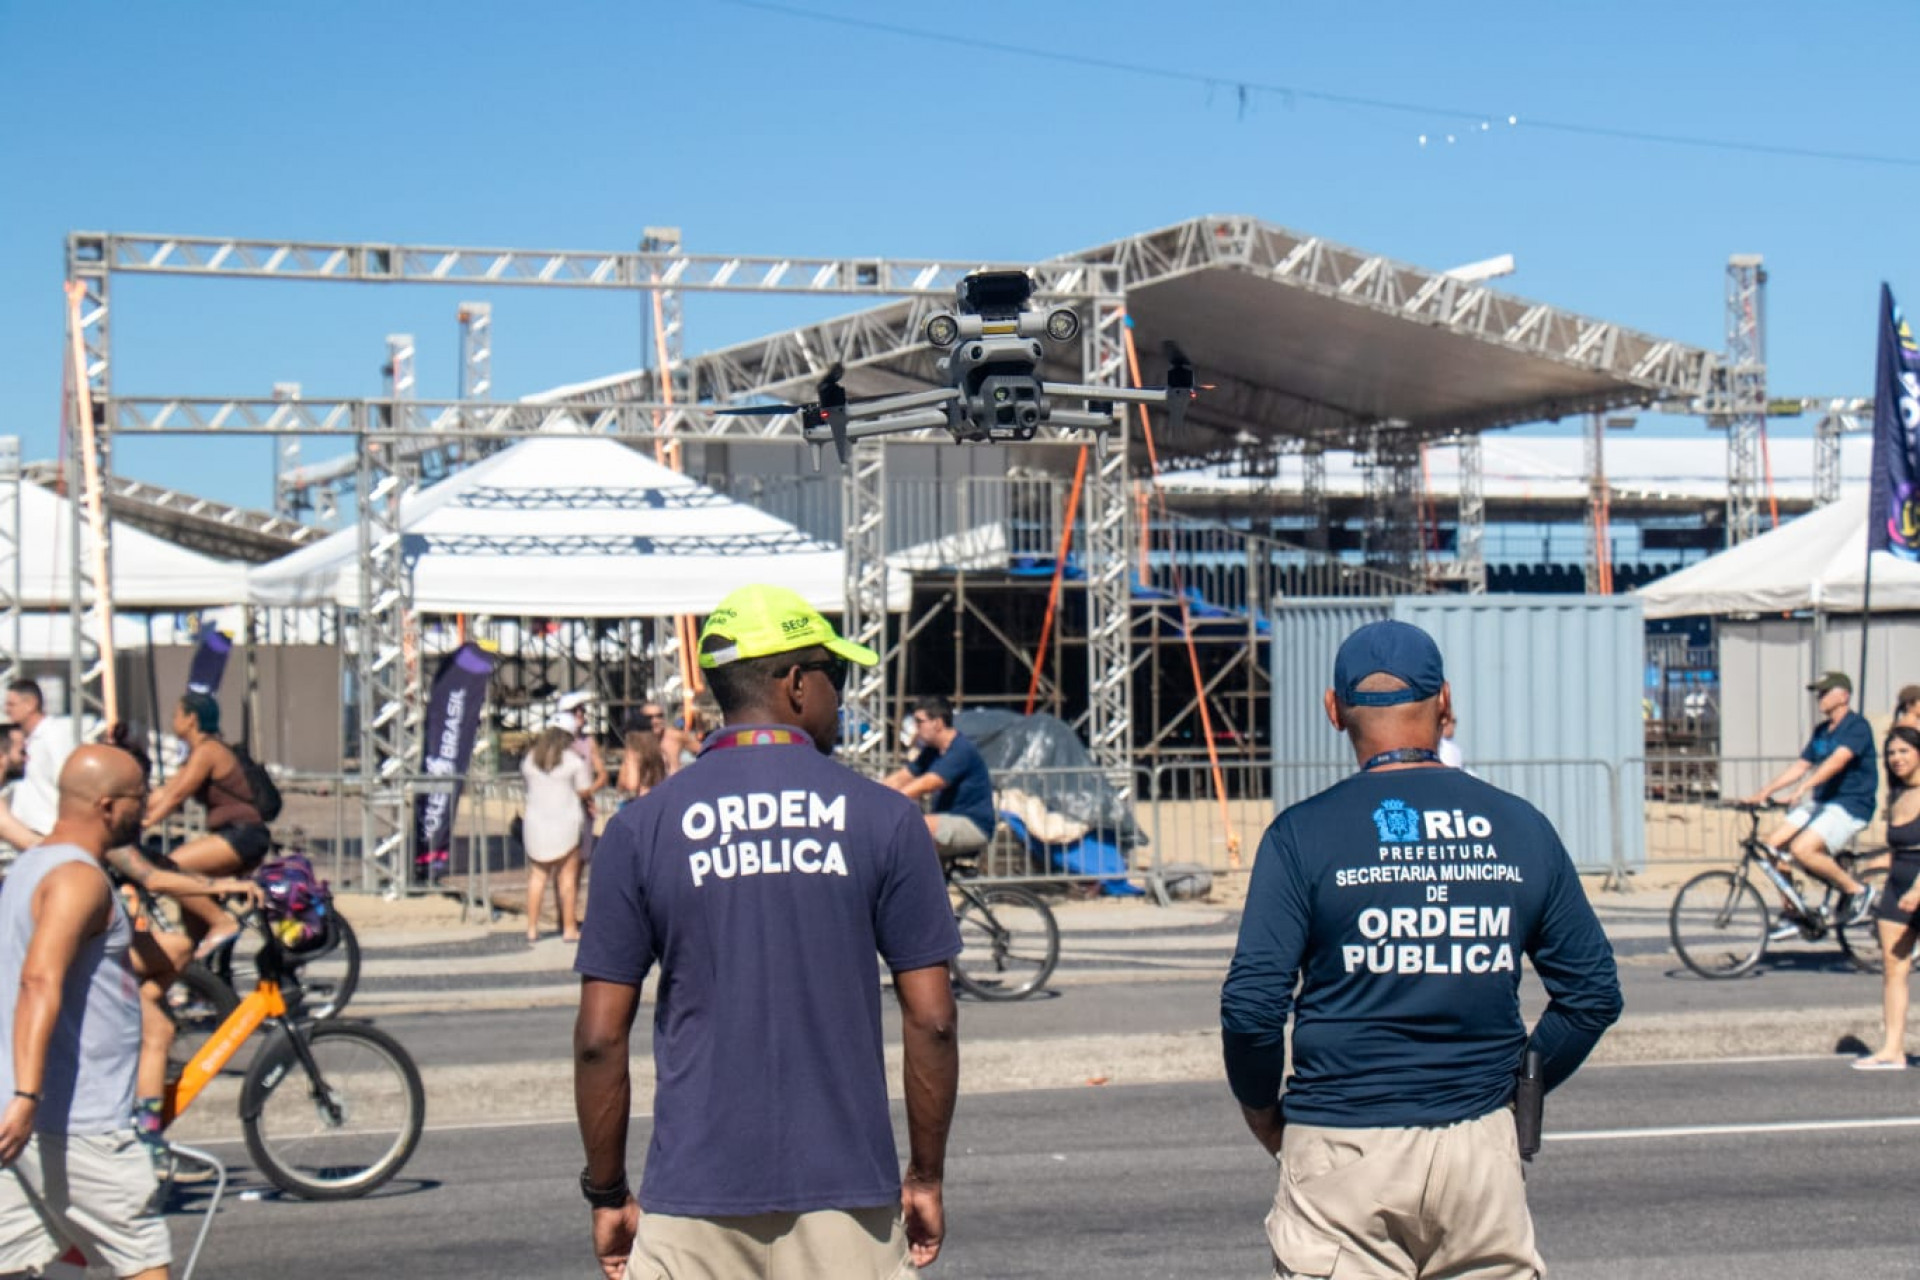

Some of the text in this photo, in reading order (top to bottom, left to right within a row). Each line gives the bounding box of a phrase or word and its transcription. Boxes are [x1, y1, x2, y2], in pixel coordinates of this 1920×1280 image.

[439, 688, 467, 759] BRASIL
[681, 790, 847, 841] ORDEM
[1423, 809, 1492, 839] Rio
[688, 833, 849, 887] PÚBLICA
[1379, 845, 1497, 861] PREFEITURA
[1335, 864, 1523, 887] SECRETARIA MUNICIPAL
[1426, 885, 1448, 902] DE
[1358, 906, 1511, 939] ORDEM
[1342, 938, 1514, 974] PÚBLICA
